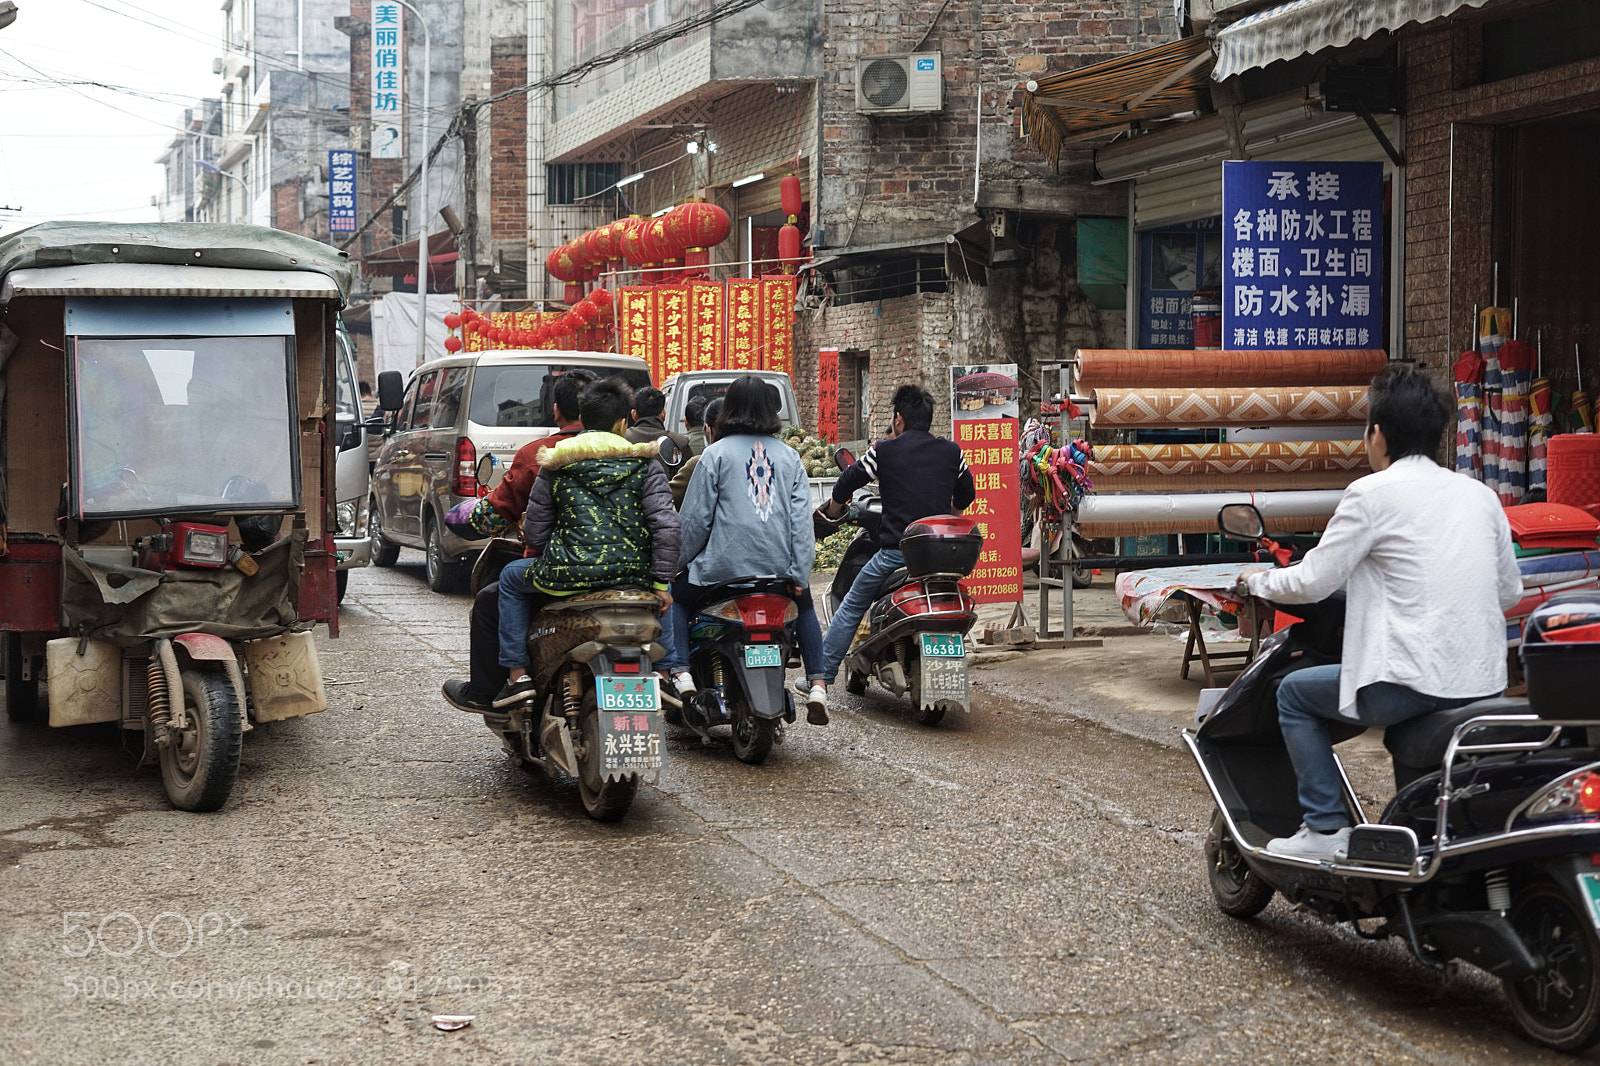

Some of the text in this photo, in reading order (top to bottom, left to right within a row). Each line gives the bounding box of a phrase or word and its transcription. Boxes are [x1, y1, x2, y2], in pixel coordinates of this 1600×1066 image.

[375, 5, 398, 111] 美丽俏佳坊
[332, 152, 353, 208] 综艺数码
[1267, 171, 1340, 201] 承接
[1233, 208, 1372, 242] 各种防水工程
[1232, 247, 1372, 277] 楼面、卫生间
[1234, 284, 1370, 317] 防水补漏
[1234, 327, 1370, 346] 清洁 快捷 不用破坏翻修
[960, 422, 1013, 442] 婚庆喜篷
[972, 473, 1007, 490] 出租、
[962, 567, 1018, 579] 788178260
[925, 644, 962, 655] 86387
[925, 660, 964, 672] 沙坪
[605, 694, 654, 708] B6353
[613, 715, 649, 731] 新福
[604, 733, 661, 756] 永兴车行
